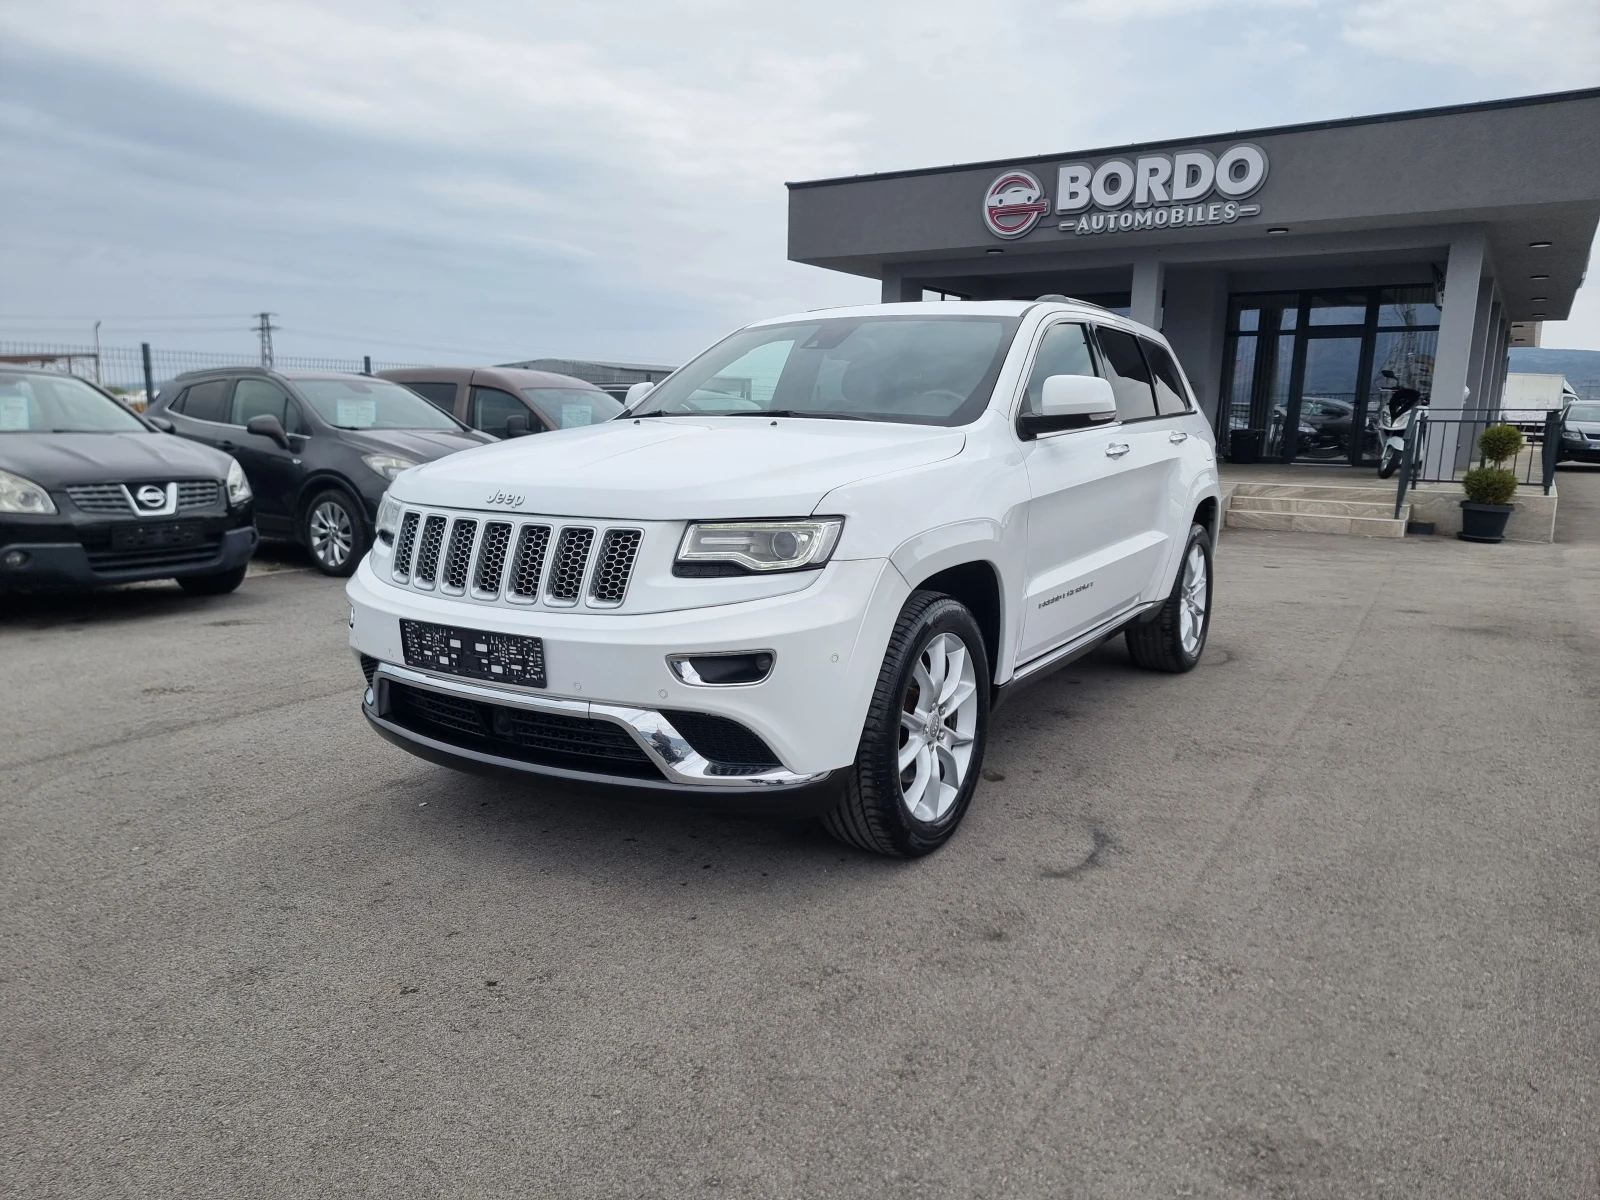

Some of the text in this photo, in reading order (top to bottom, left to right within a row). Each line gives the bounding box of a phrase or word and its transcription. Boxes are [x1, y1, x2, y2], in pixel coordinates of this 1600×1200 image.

[1057, 146, 1264, 211] BORDO
[1077, 203, 1236, 232] AUTOMOBILES
[485, 489, 526, 509] Jeep
